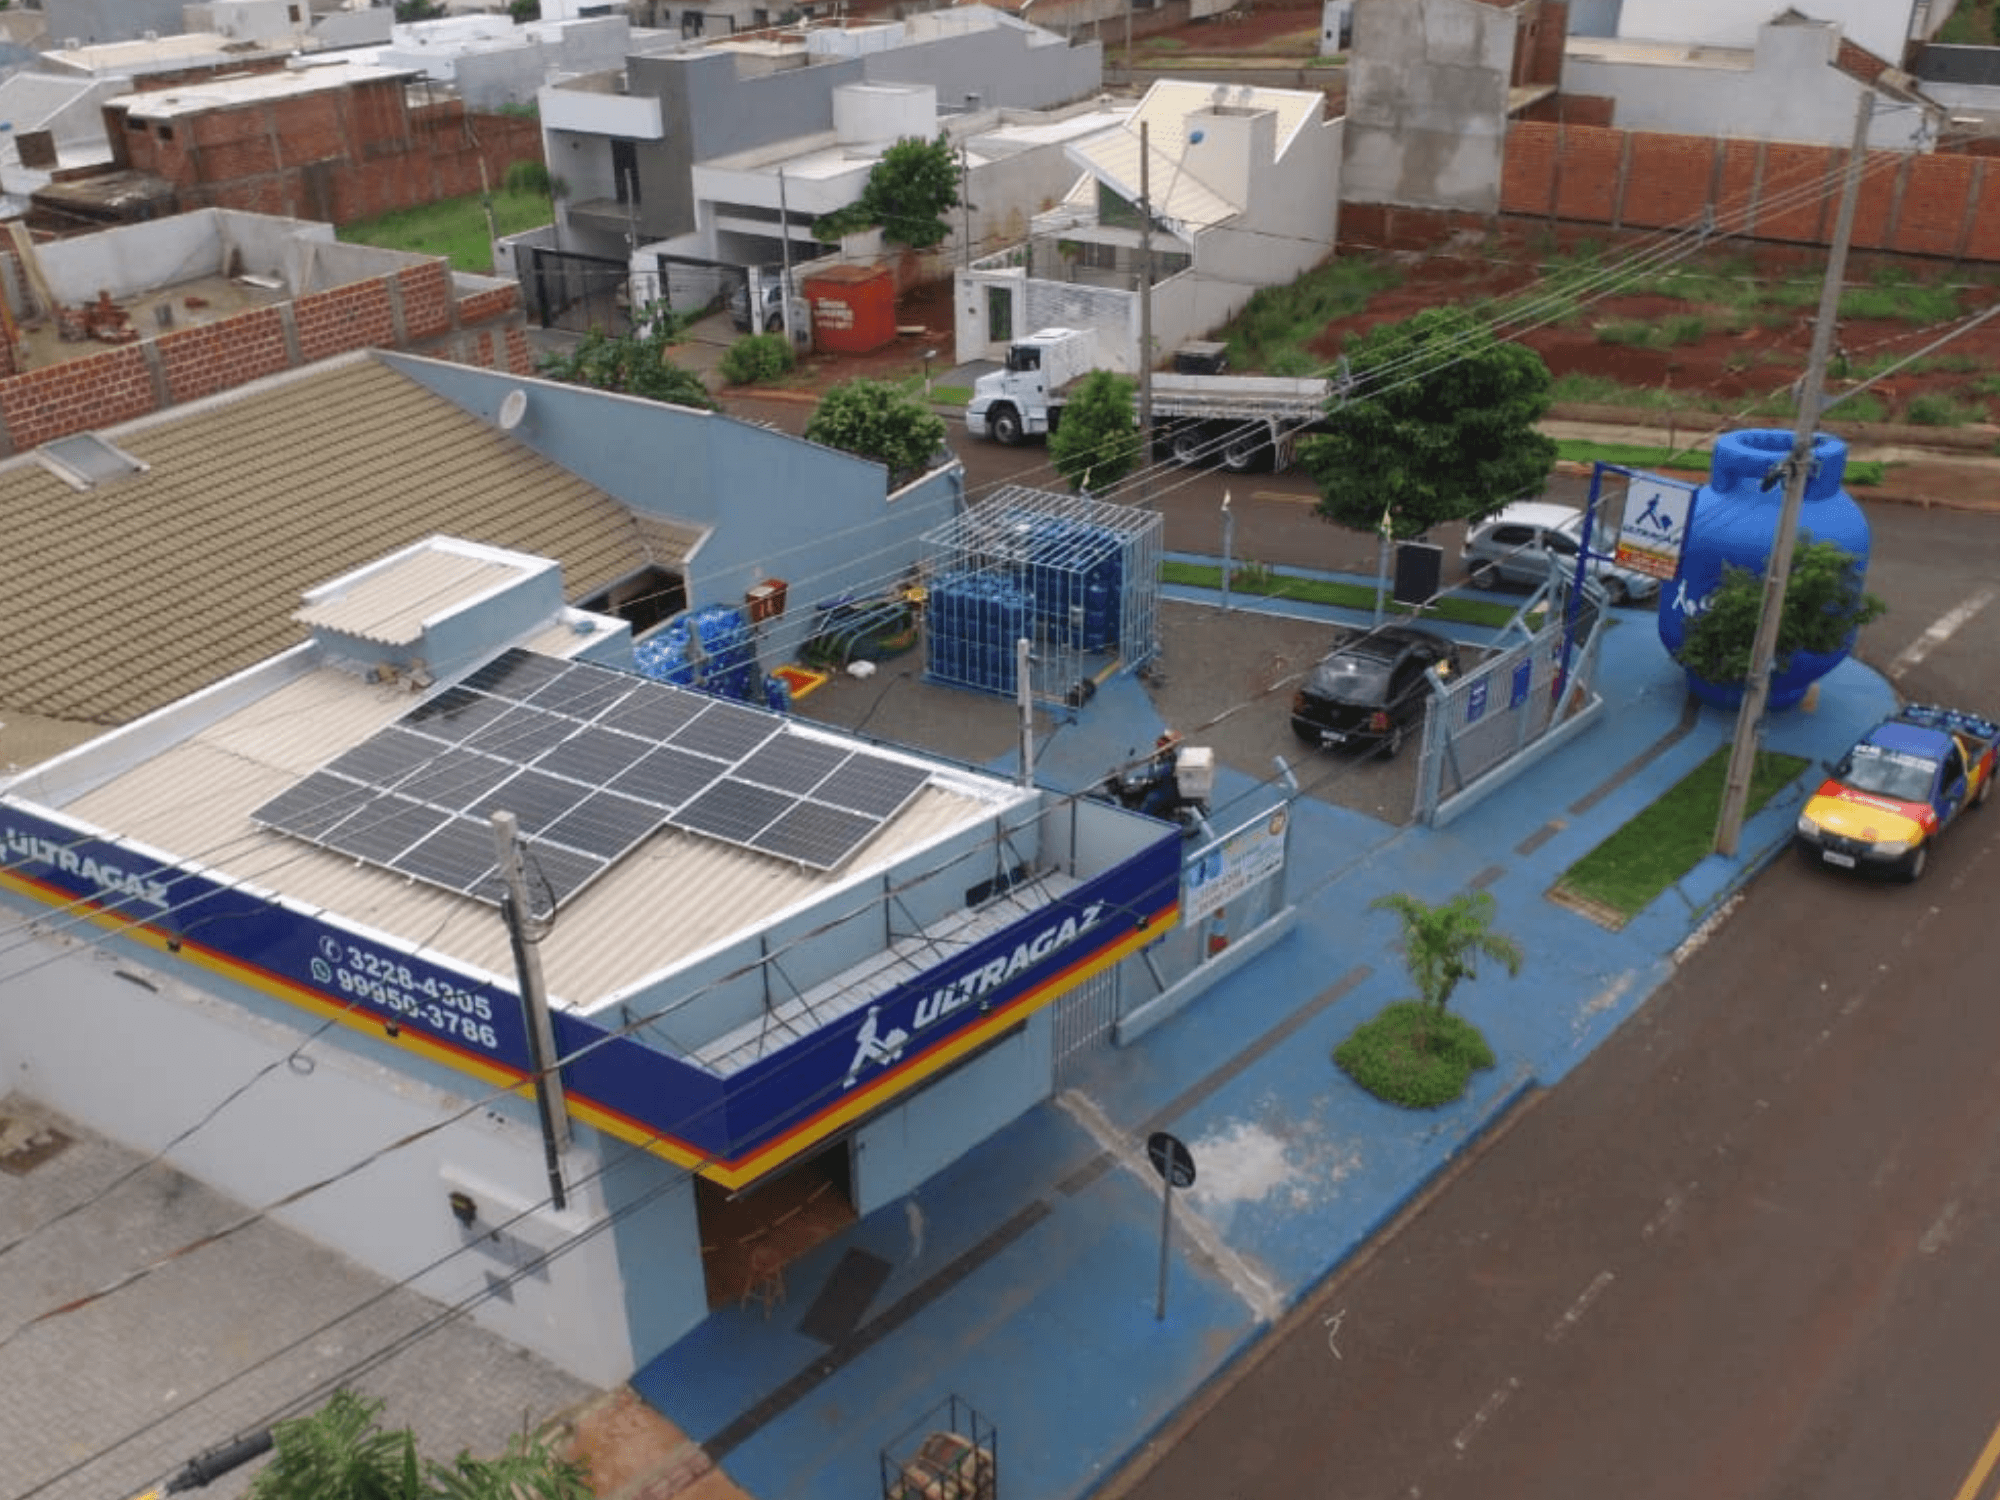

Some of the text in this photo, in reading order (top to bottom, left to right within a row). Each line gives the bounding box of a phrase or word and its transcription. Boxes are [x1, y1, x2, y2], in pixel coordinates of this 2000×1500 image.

[6, 827, 169, 909] ULTRAGAZ
[348, 946, 492, 1020] 3228-4305
[913, 898, 1104, 1029] ULTRAGAZ
